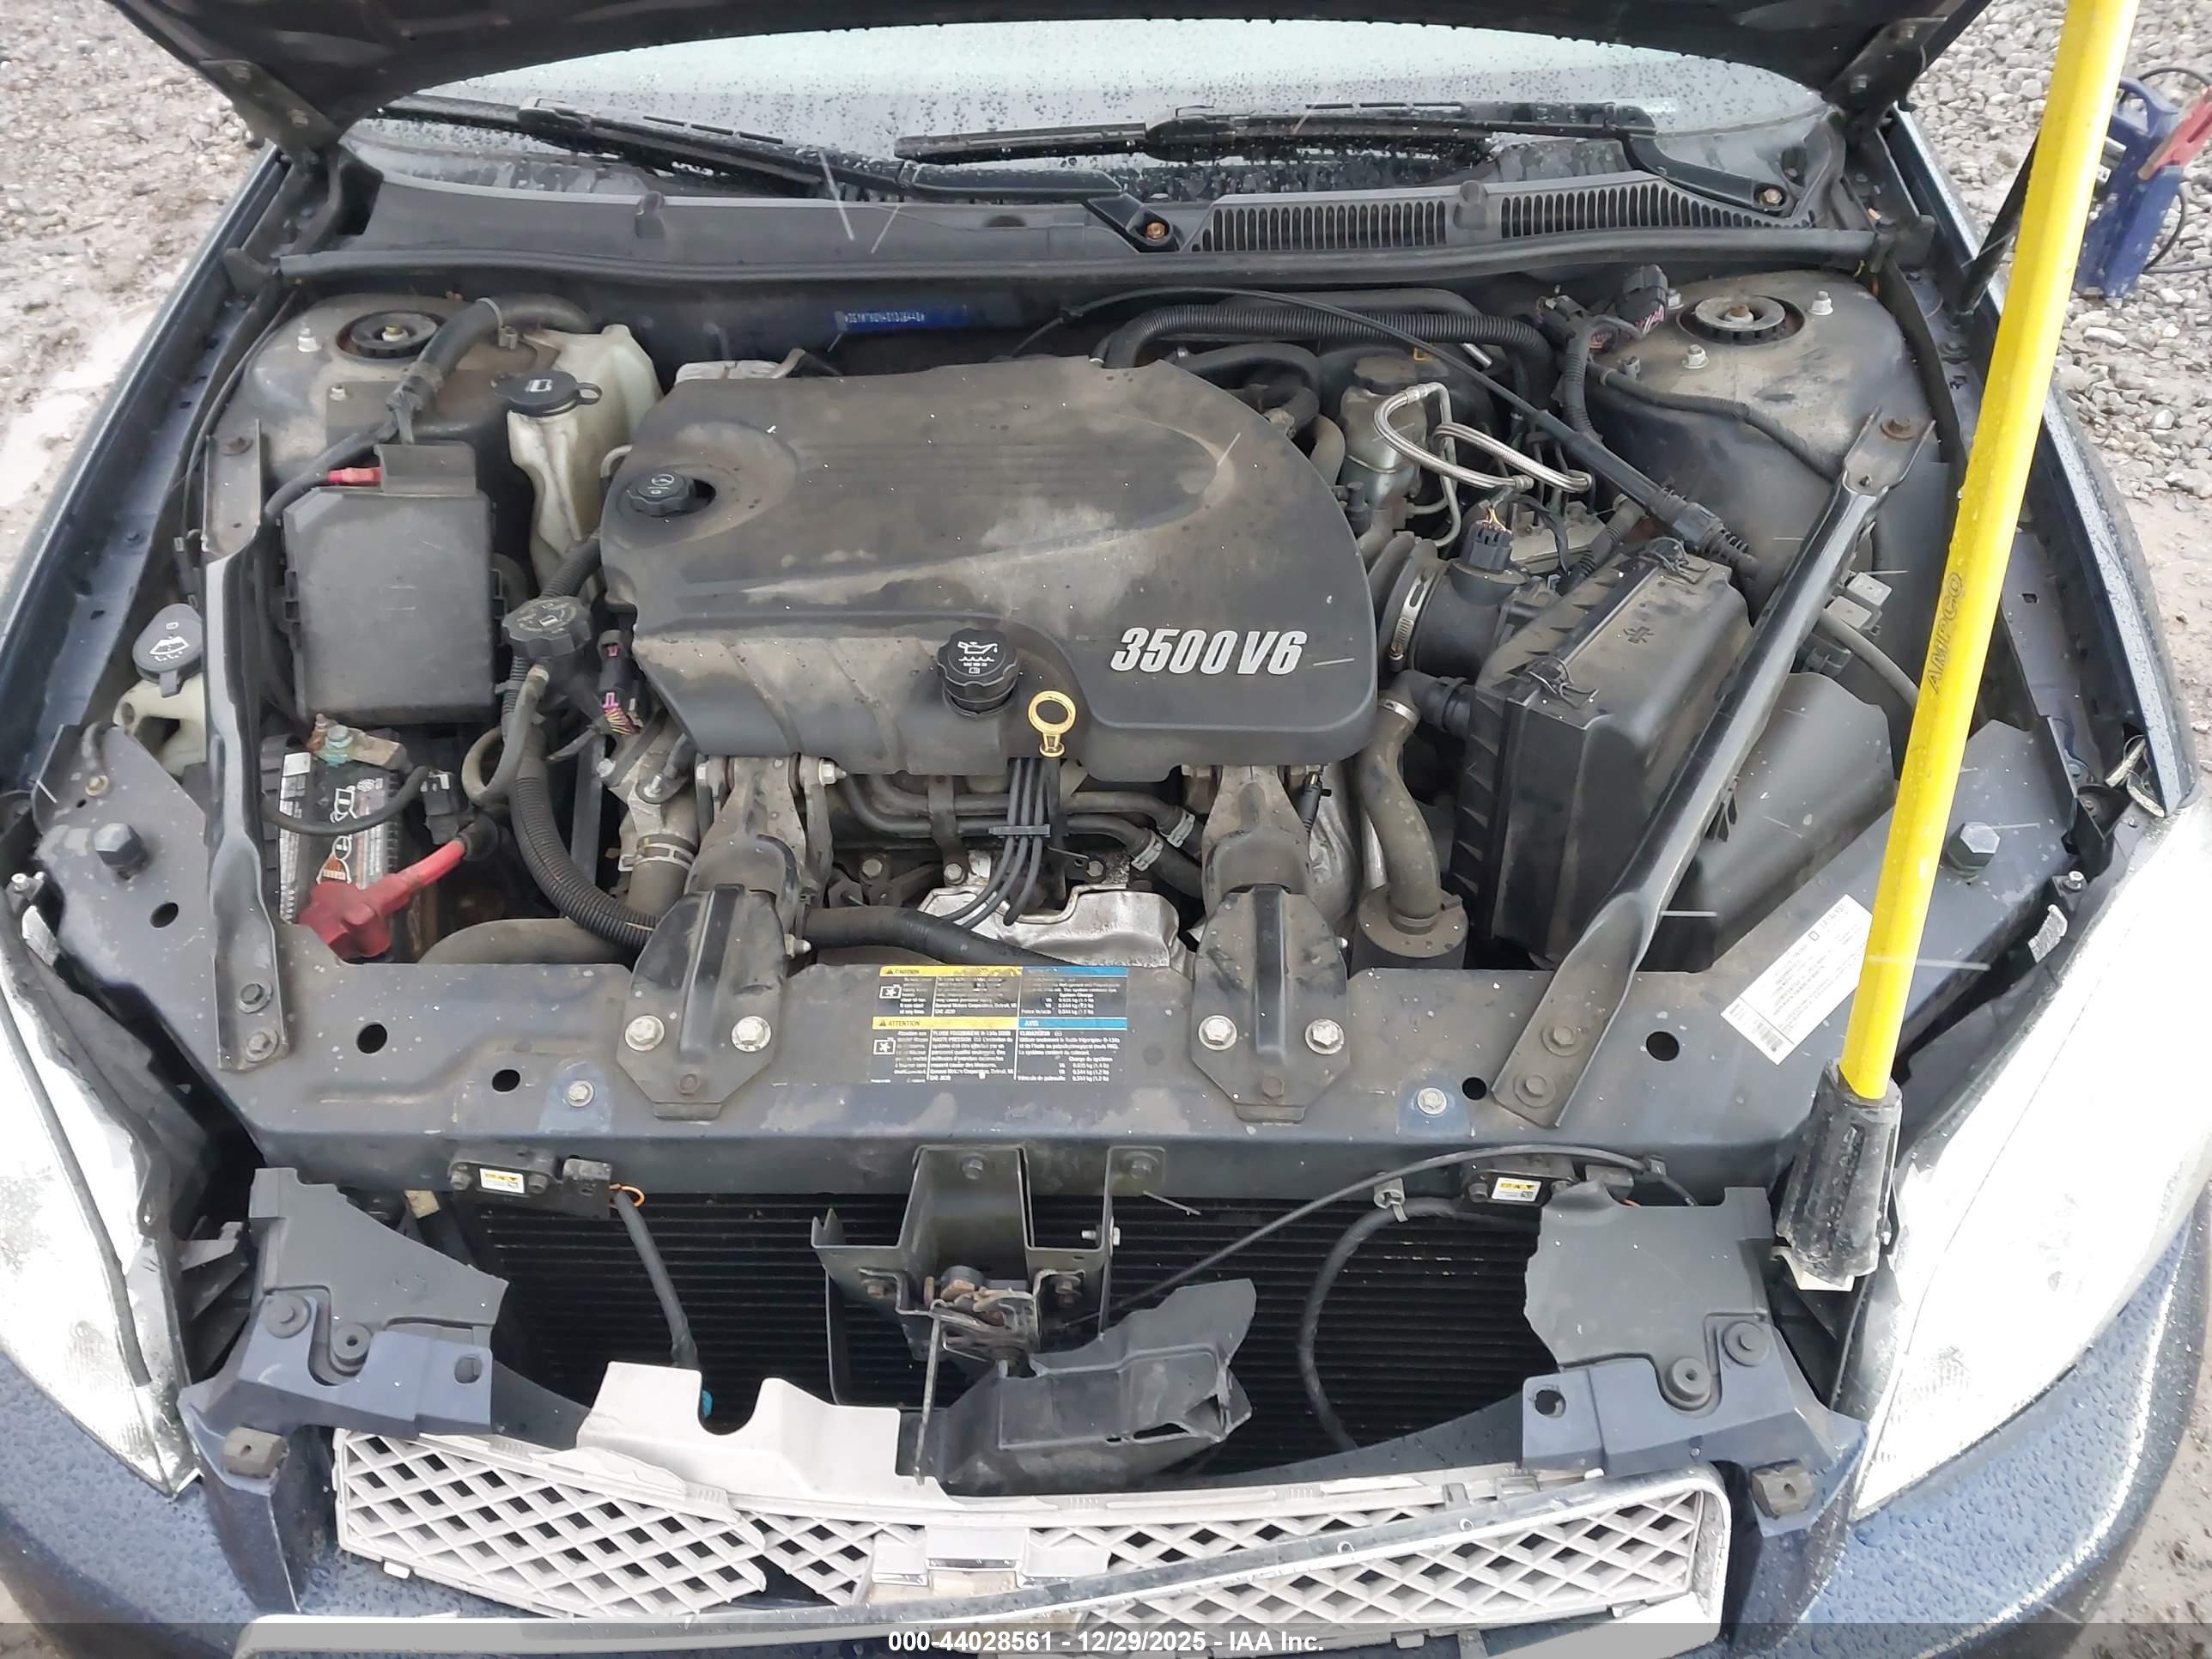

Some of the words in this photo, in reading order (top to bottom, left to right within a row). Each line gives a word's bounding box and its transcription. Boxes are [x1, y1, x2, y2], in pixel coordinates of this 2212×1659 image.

[1110, 627, 1239, 675] 3500
[1237, 629, 1308, 675] V6
[1927, 571, 1963, 695] AMPCO
